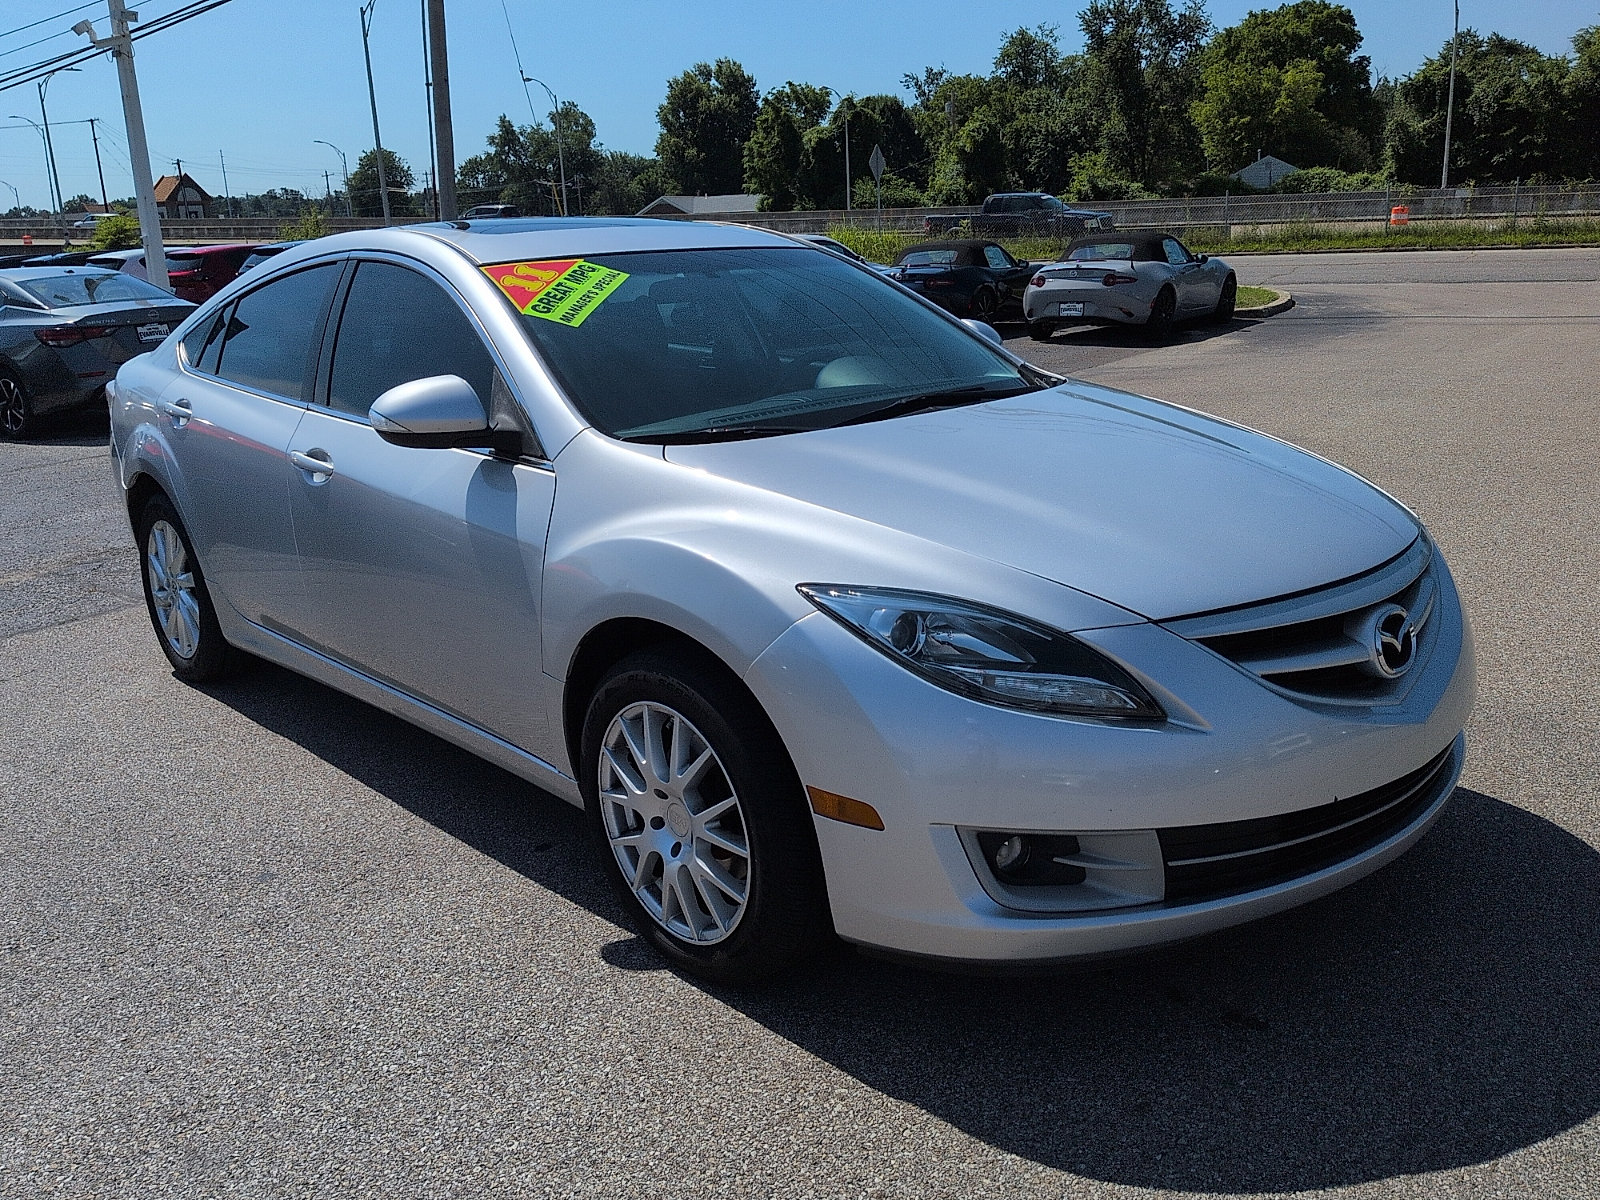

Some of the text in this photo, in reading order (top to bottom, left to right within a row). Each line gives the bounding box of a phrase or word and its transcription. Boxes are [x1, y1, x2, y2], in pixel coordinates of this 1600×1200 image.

[500, 264, 559, 292] 11
[531, 264, 599, 314] GREAT MPG
[594, 270, 621, 291] SPECIAL
